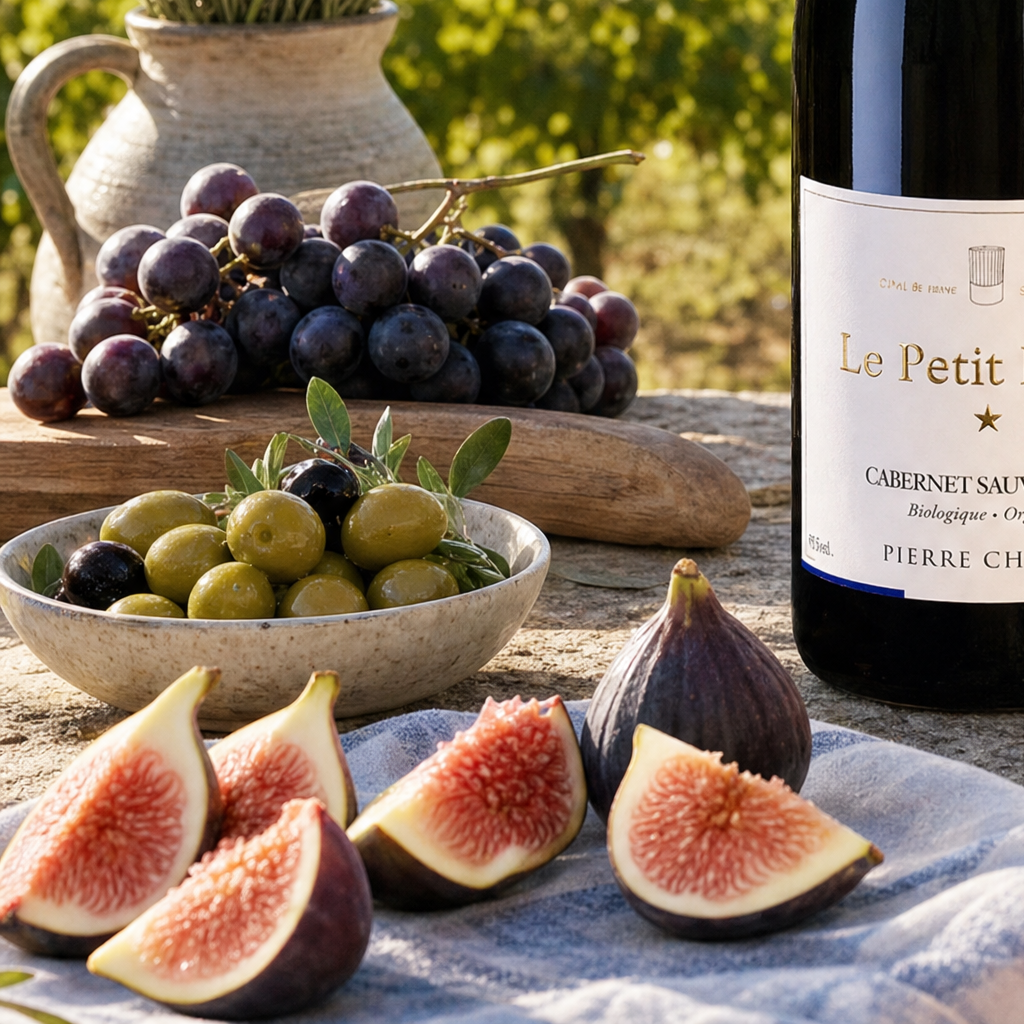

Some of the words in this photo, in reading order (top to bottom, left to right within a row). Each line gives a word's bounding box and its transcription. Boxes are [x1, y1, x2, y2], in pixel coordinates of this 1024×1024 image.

[840, 331, 883, 378] Le
[898, 341, 1005, 386] Petit
[865, 465, 973, 494] CABERNET
[907, 502, 988, 525] Biologique
[883, 543, 971, 569] PIERRE
